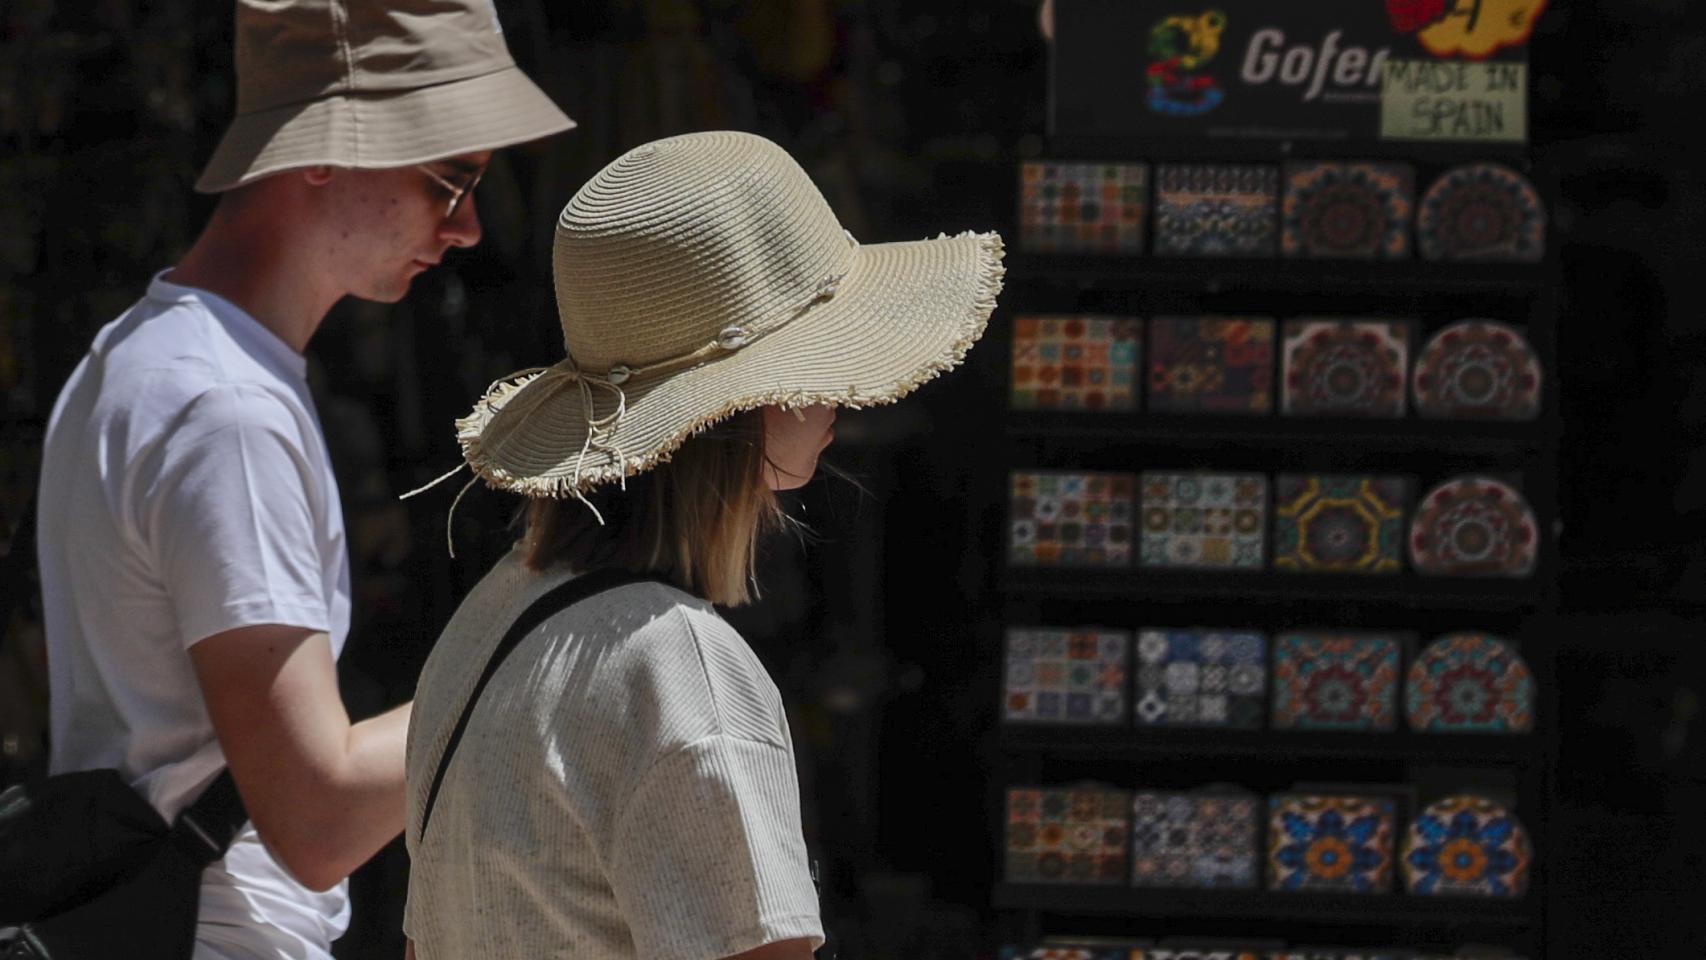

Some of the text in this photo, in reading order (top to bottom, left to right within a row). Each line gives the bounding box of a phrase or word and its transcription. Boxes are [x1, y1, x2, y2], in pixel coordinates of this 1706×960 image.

[1241, 28, 1391, 101] Gofer
[1386, 62, 1519, 93] MADE IN
[1411, 96, 1504, 137] SPAIN
